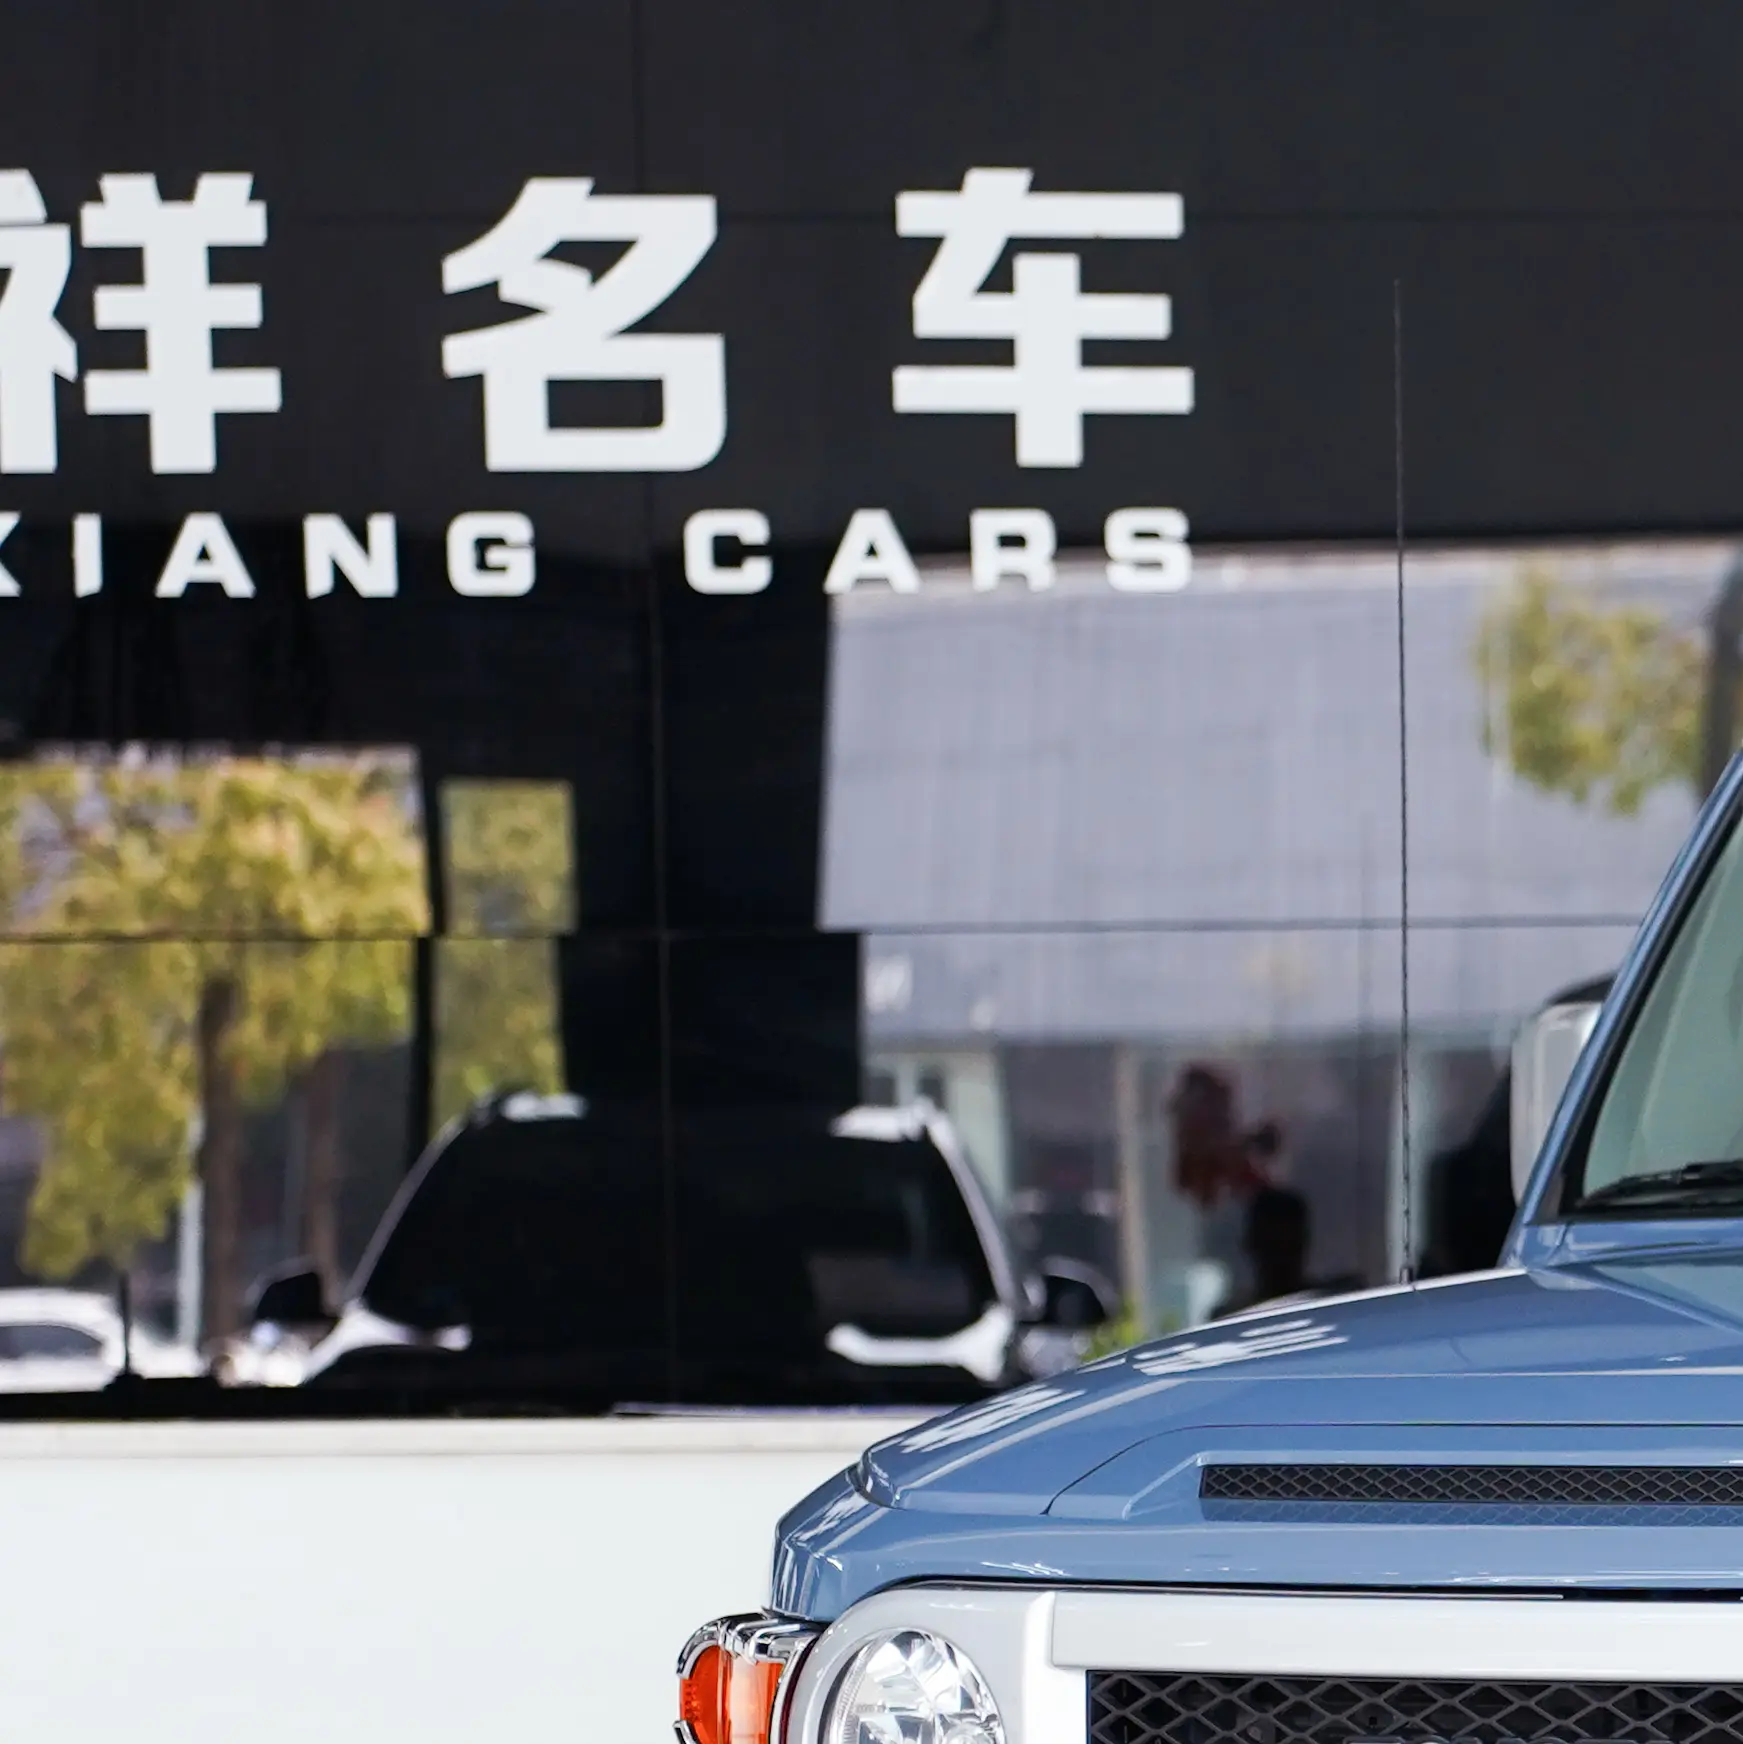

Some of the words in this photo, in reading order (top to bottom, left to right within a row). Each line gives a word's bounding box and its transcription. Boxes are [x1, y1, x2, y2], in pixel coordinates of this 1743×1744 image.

[0, 168, 1195, 474] 祥名车
[682, 506, 1193, 597] CARS
